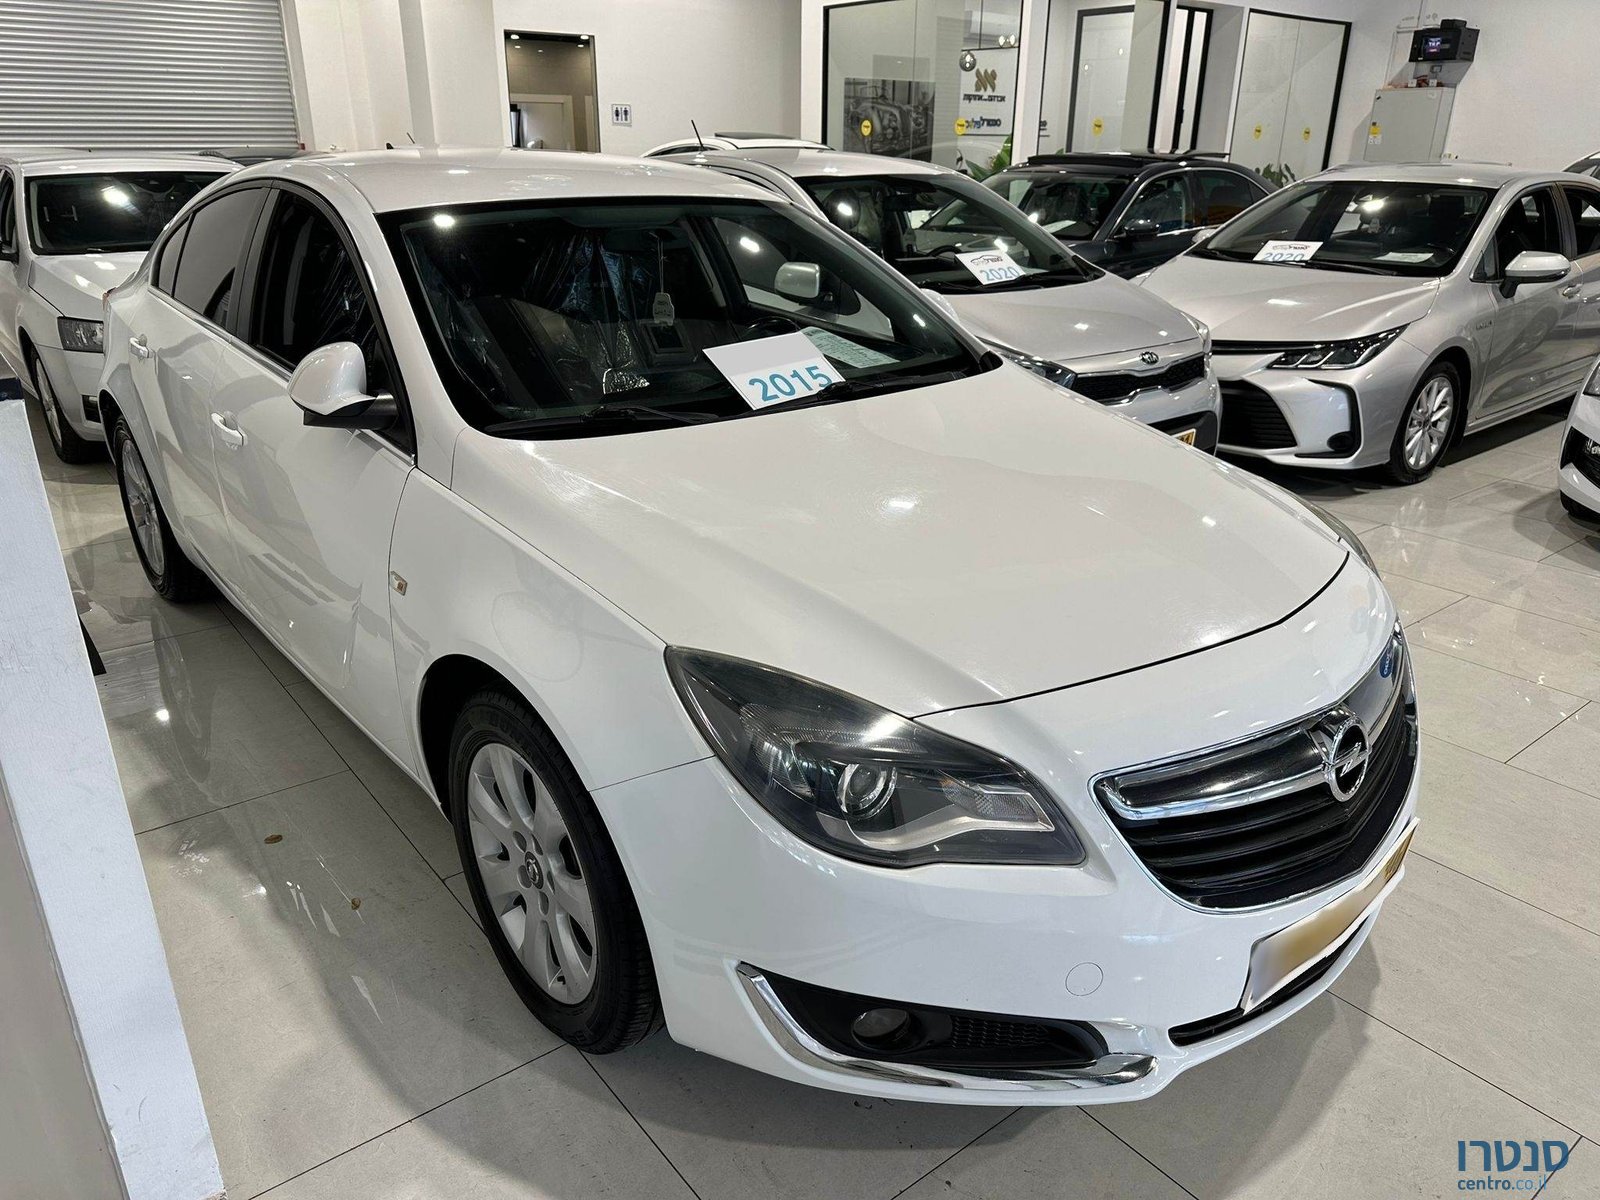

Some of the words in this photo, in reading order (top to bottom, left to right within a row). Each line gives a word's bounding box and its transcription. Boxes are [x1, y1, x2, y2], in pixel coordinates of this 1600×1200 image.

[1264, 252, 1305, 261] 2020
[979, 266, 1021, 281] 2020
[748, 365, 833, 402] 2015
